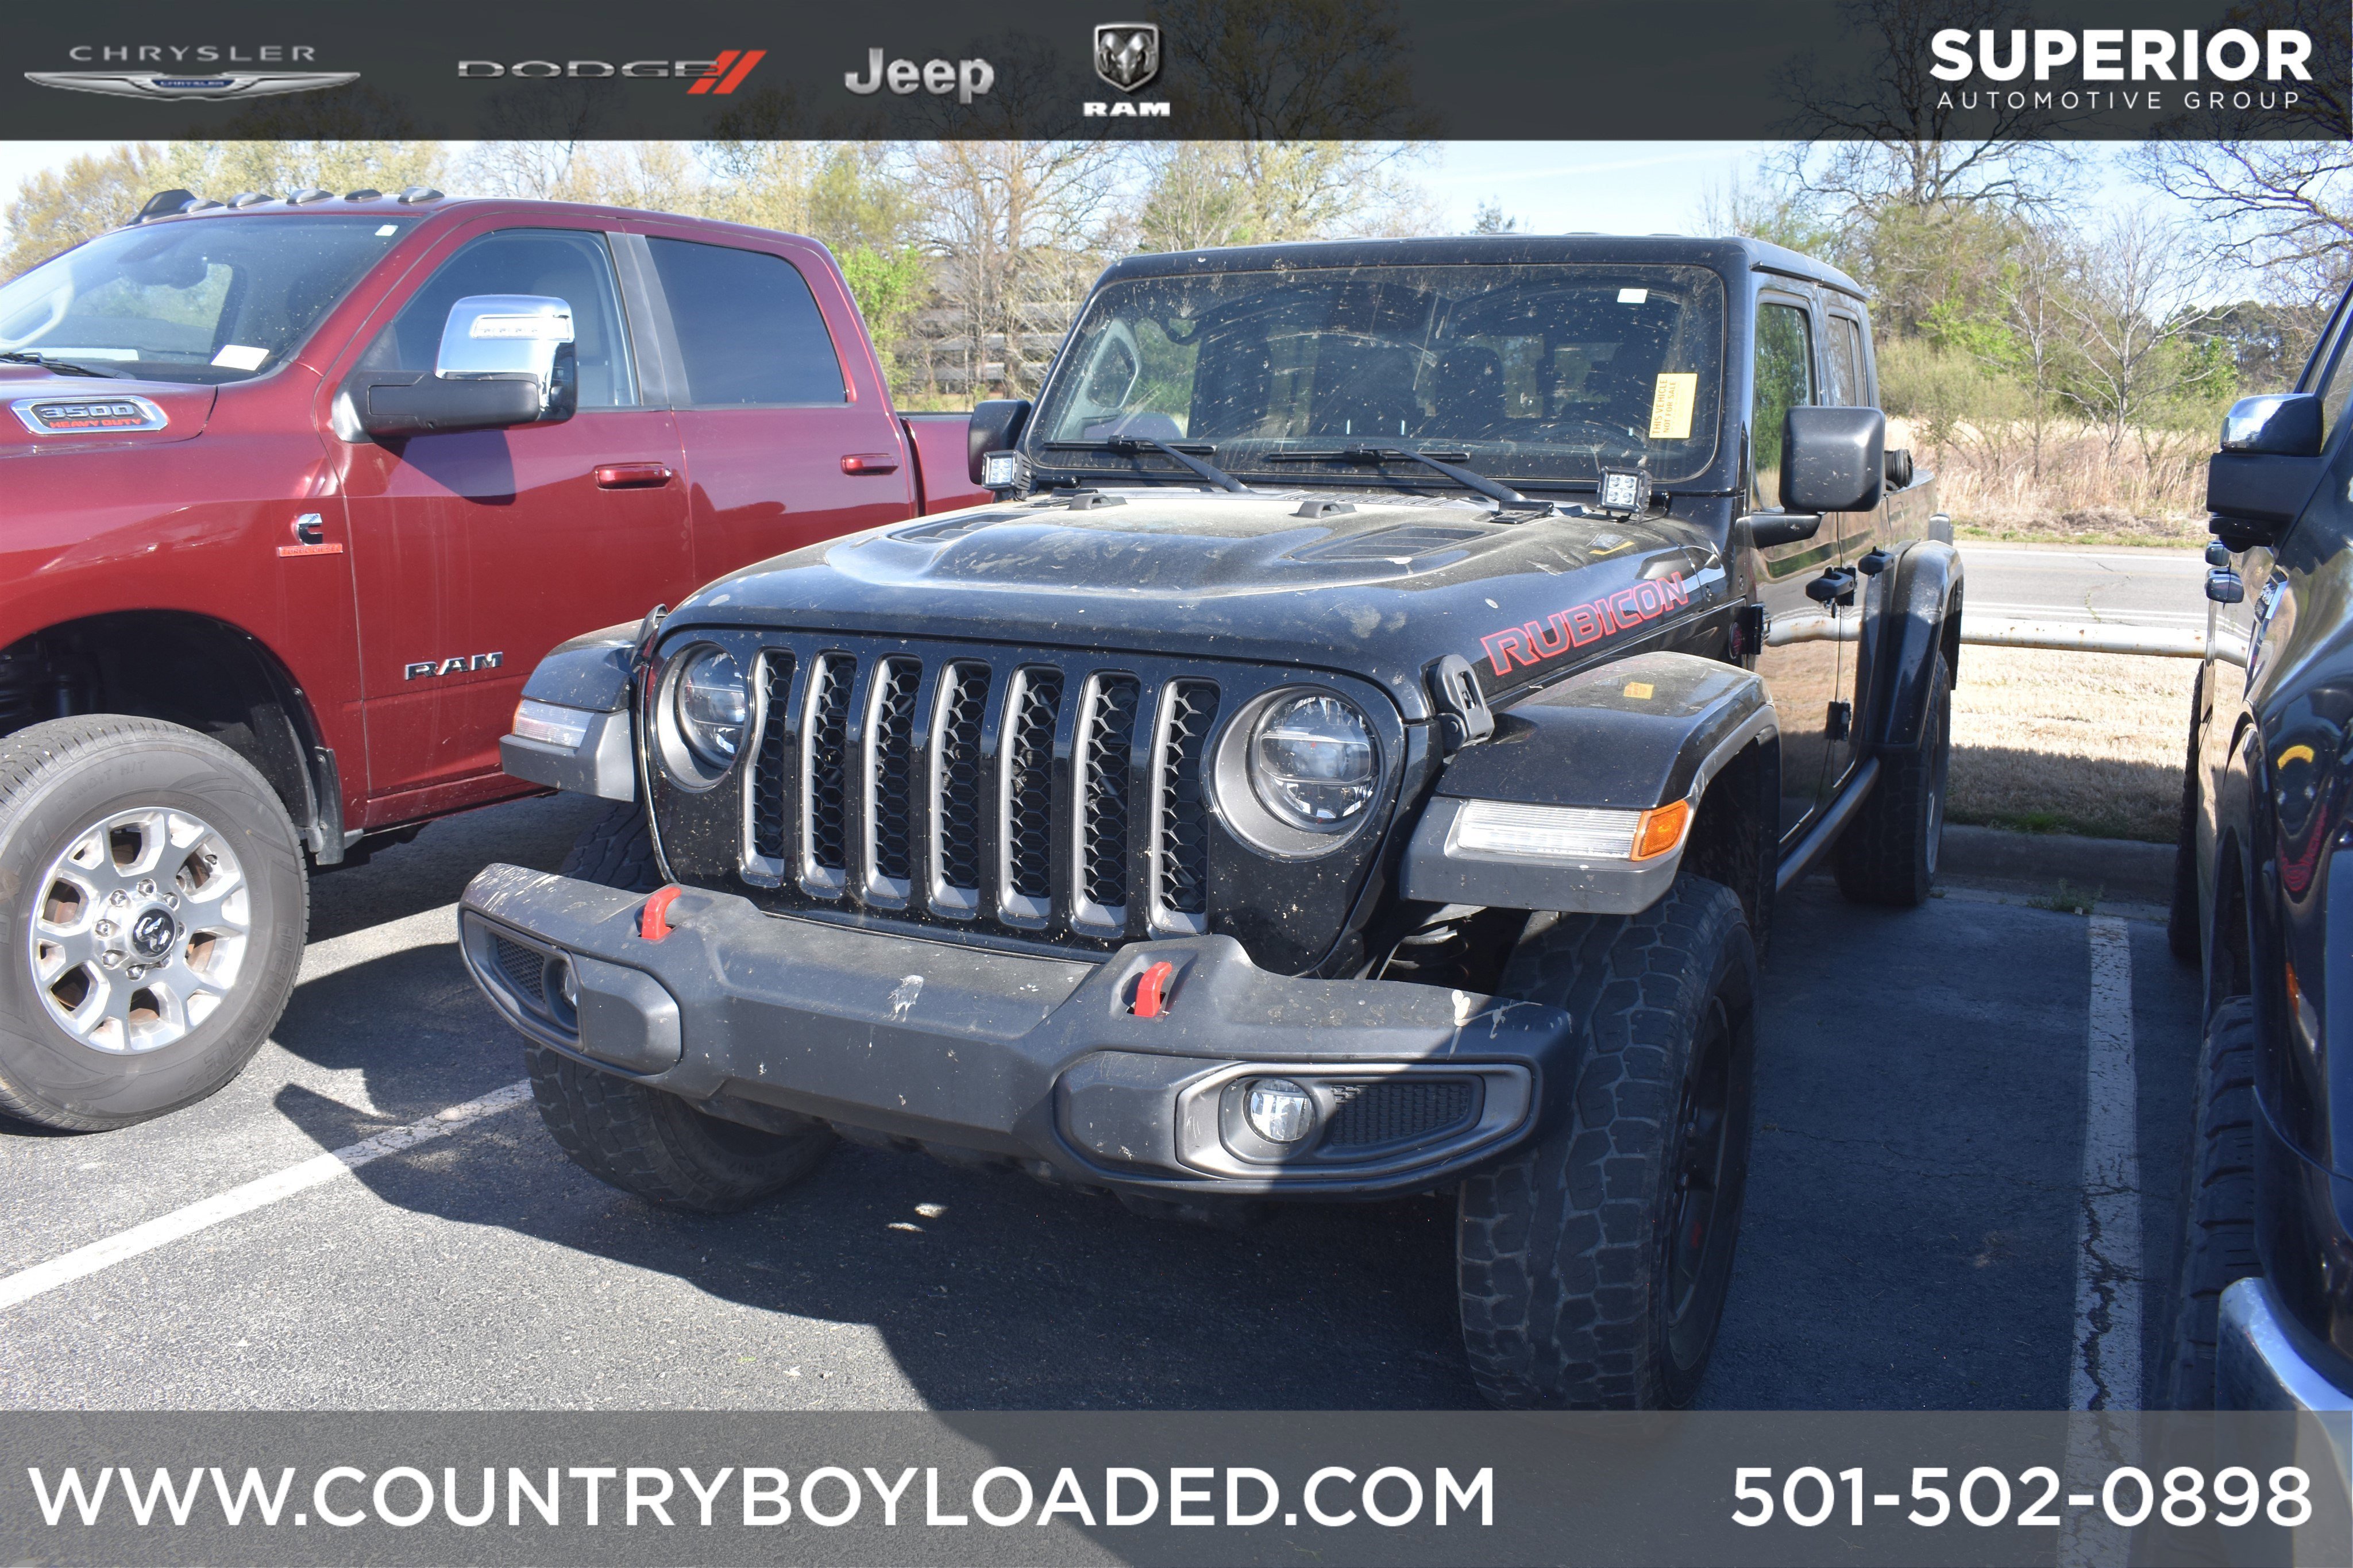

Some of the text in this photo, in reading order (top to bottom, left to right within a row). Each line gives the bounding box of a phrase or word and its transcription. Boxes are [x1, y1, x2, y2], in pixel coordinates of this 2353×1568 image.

[1668, 381, 1676, 399] SALE
[40, 405, 136, 419] 3500
[1652, 379, 1668, 434] THIS VEHICLE
[49, 418, 142, 428] HEAVY DUTY
[1480, 571, 1689, 676] RUBICON
[405, 651, 503, 680] RAM
